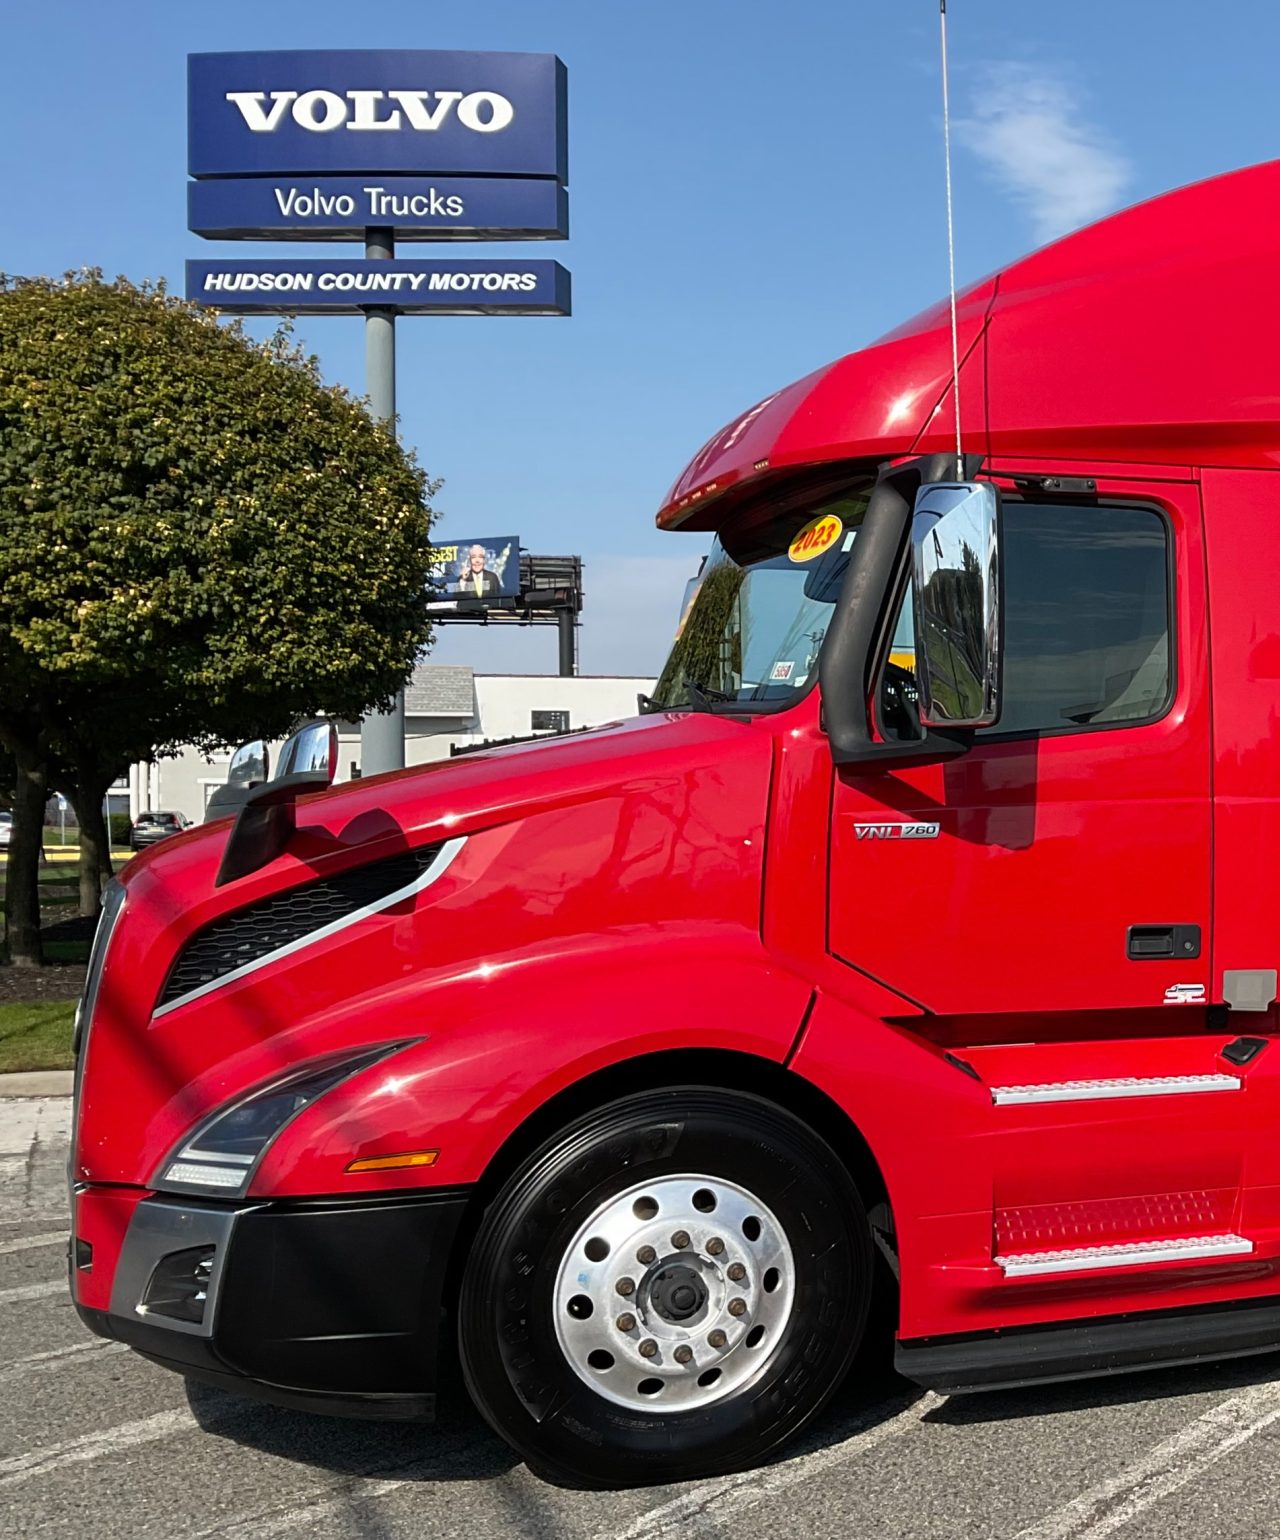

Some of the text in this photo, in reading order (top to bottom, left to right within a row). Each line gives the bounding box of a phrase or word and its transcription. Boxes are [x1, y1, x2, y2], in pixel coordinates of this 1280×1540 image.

[226, 90, 514, 133] VOLVO
[275, 187, 464, 217] Volvo Trucks
[204, 273, 537, 291] HUDSON COUNTY MOTORS
[793, 522, 836, 554] 2023
[855, 825, 936, 839] VNL 760
